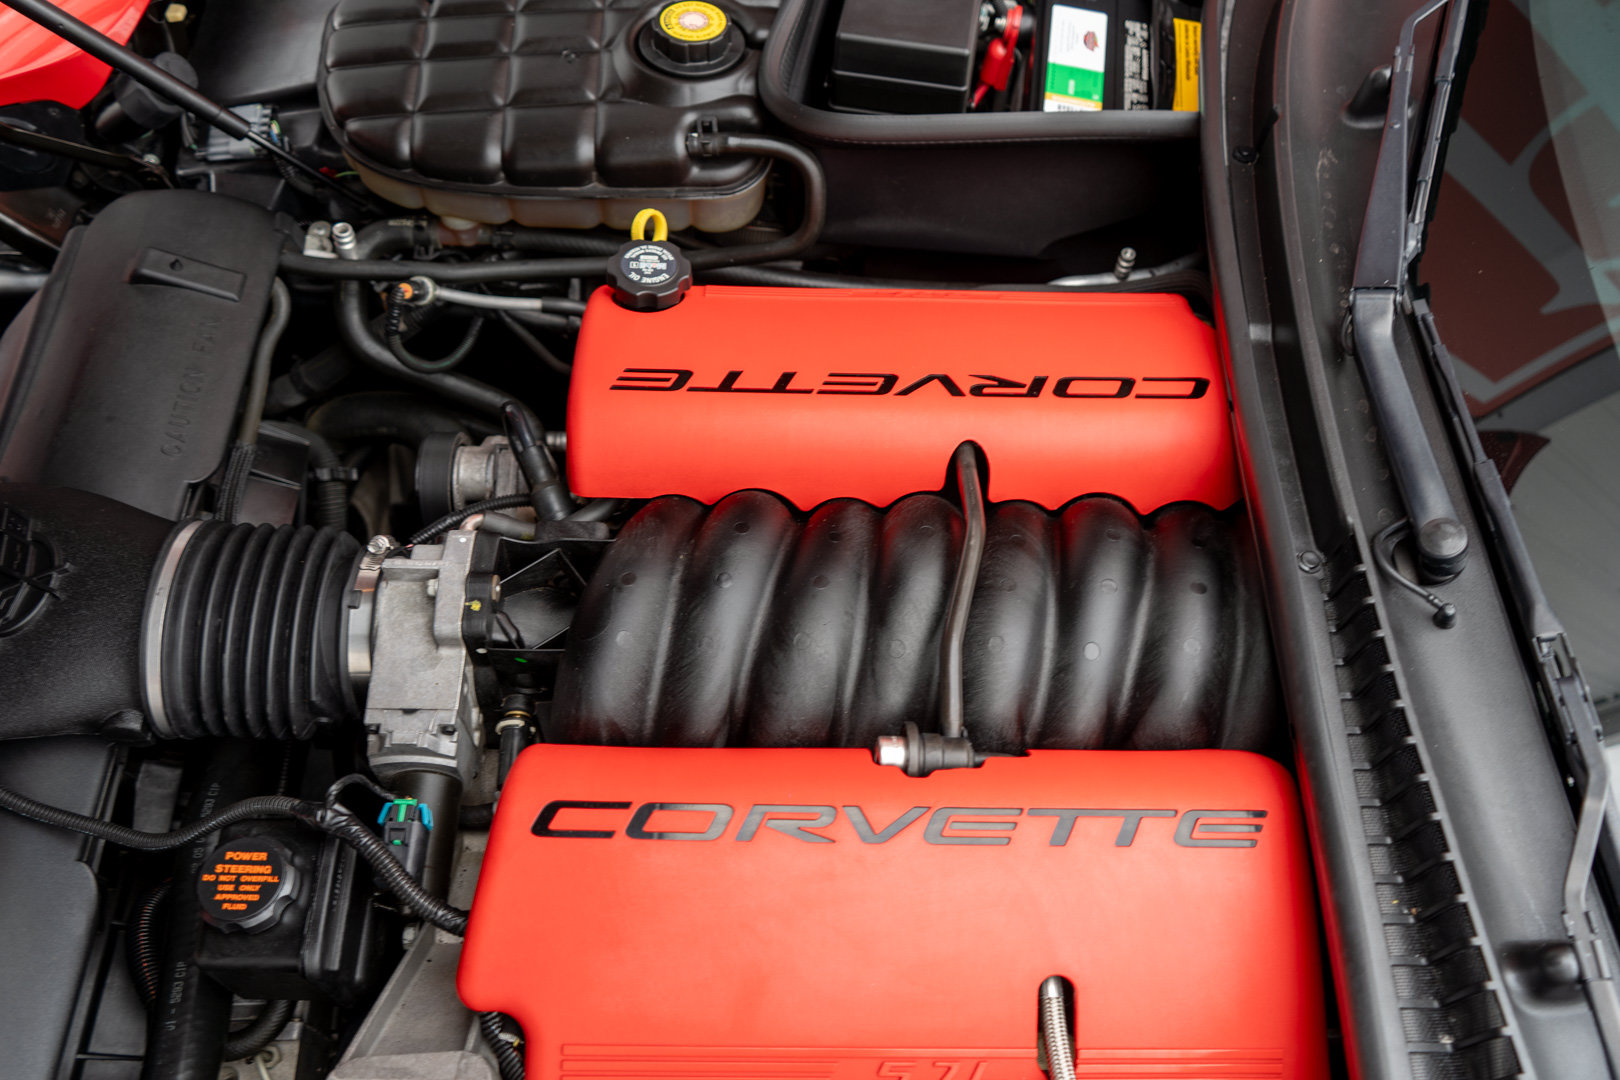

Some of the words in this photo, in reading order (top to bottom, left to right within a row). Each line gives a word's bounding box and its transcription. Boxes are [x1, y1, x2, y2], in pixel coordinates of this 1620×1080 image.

[628, 271, 641, 281] OIL
[641, 273, 670, 283] ENGINE
[608, 367, 1211, 400] CORVETTE
[530, 799, 1269, 849] CORVETTE
[224, 851, 268, 861] POWER
[214, 863, 273, 874] STEERING
[201, 873, 217, 882] DO
[217, 874, 238, 882] NOT
[239, 874, 280, 883] OVERFILL
[238, 884, 262, 892] ONLY
[213, 893, 260, 901] APPROVED
[221, 902, 248, 911] FLUID
